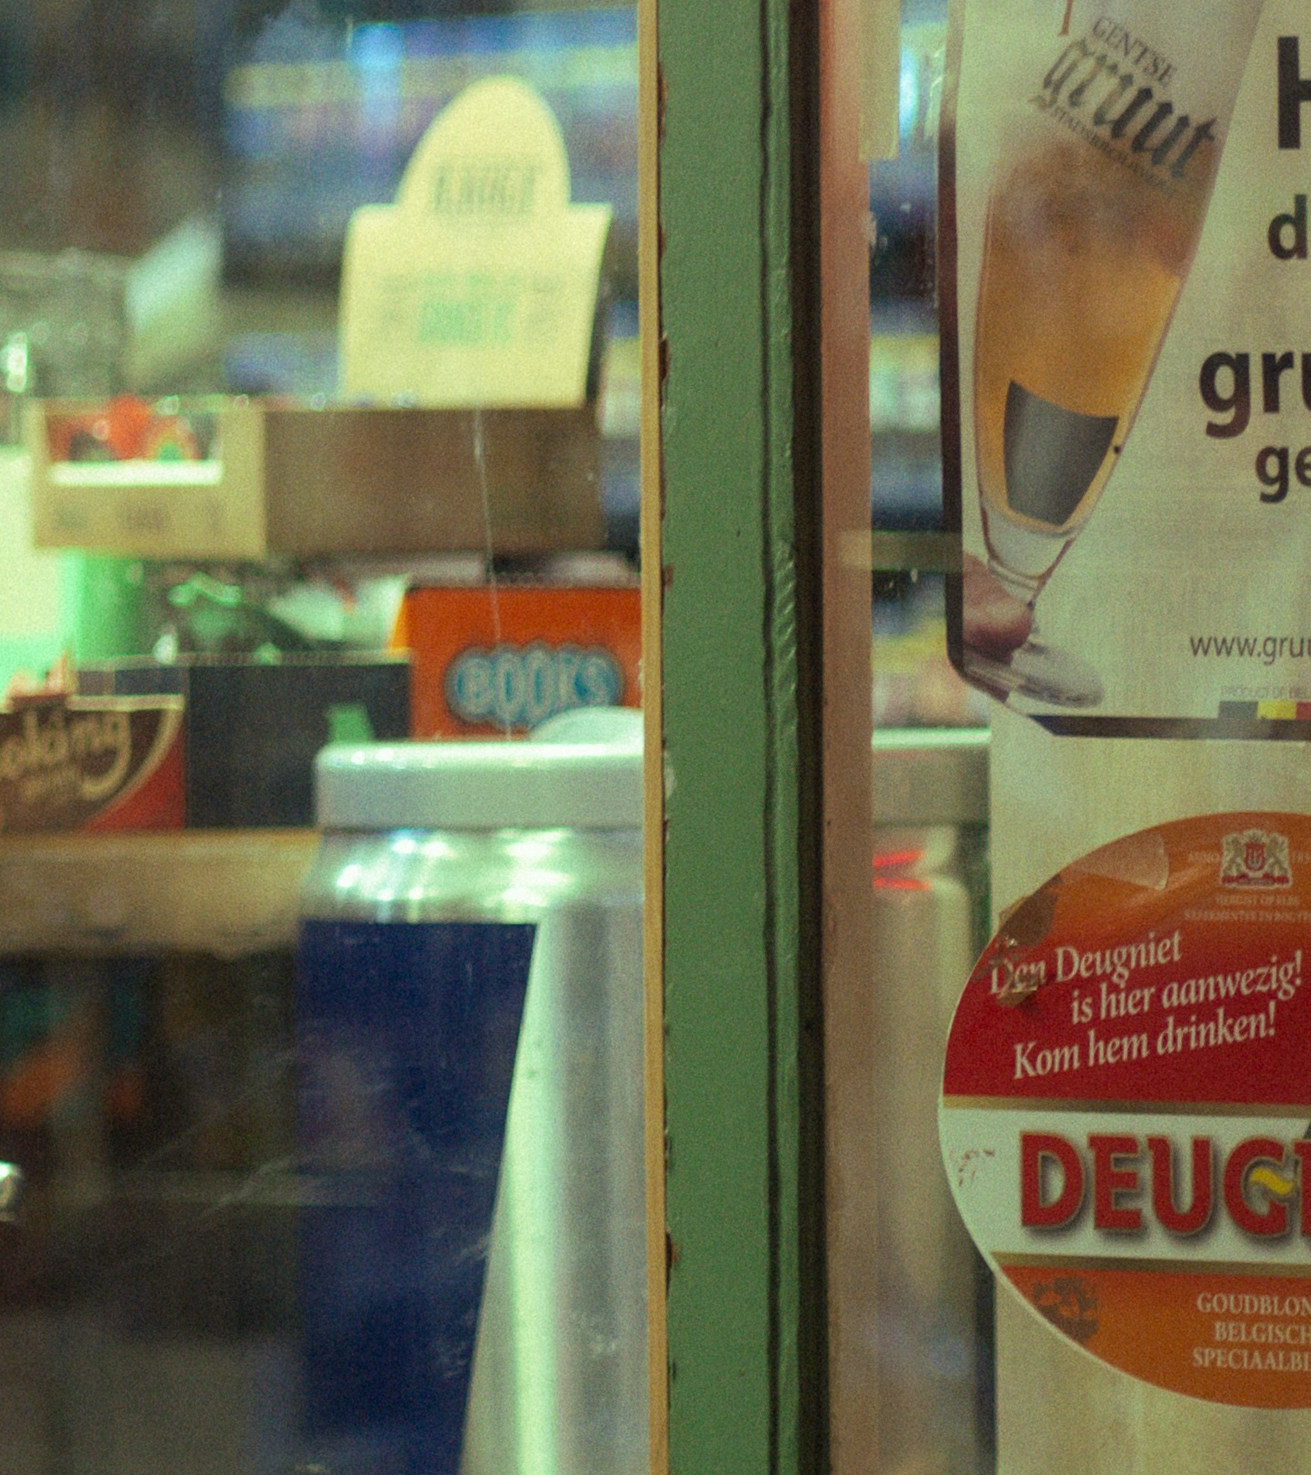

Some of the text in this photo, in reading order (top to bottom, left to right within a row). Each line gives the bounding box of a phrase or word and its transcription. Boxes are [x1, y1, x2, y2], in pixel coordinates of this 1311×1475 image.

[1055, 929, 1183, 986] Deugniet
[1070, 949, 1303, 1026] is hier aanwezig!
[1013, 1000, 1277, 1081] Kom hem drinken!
